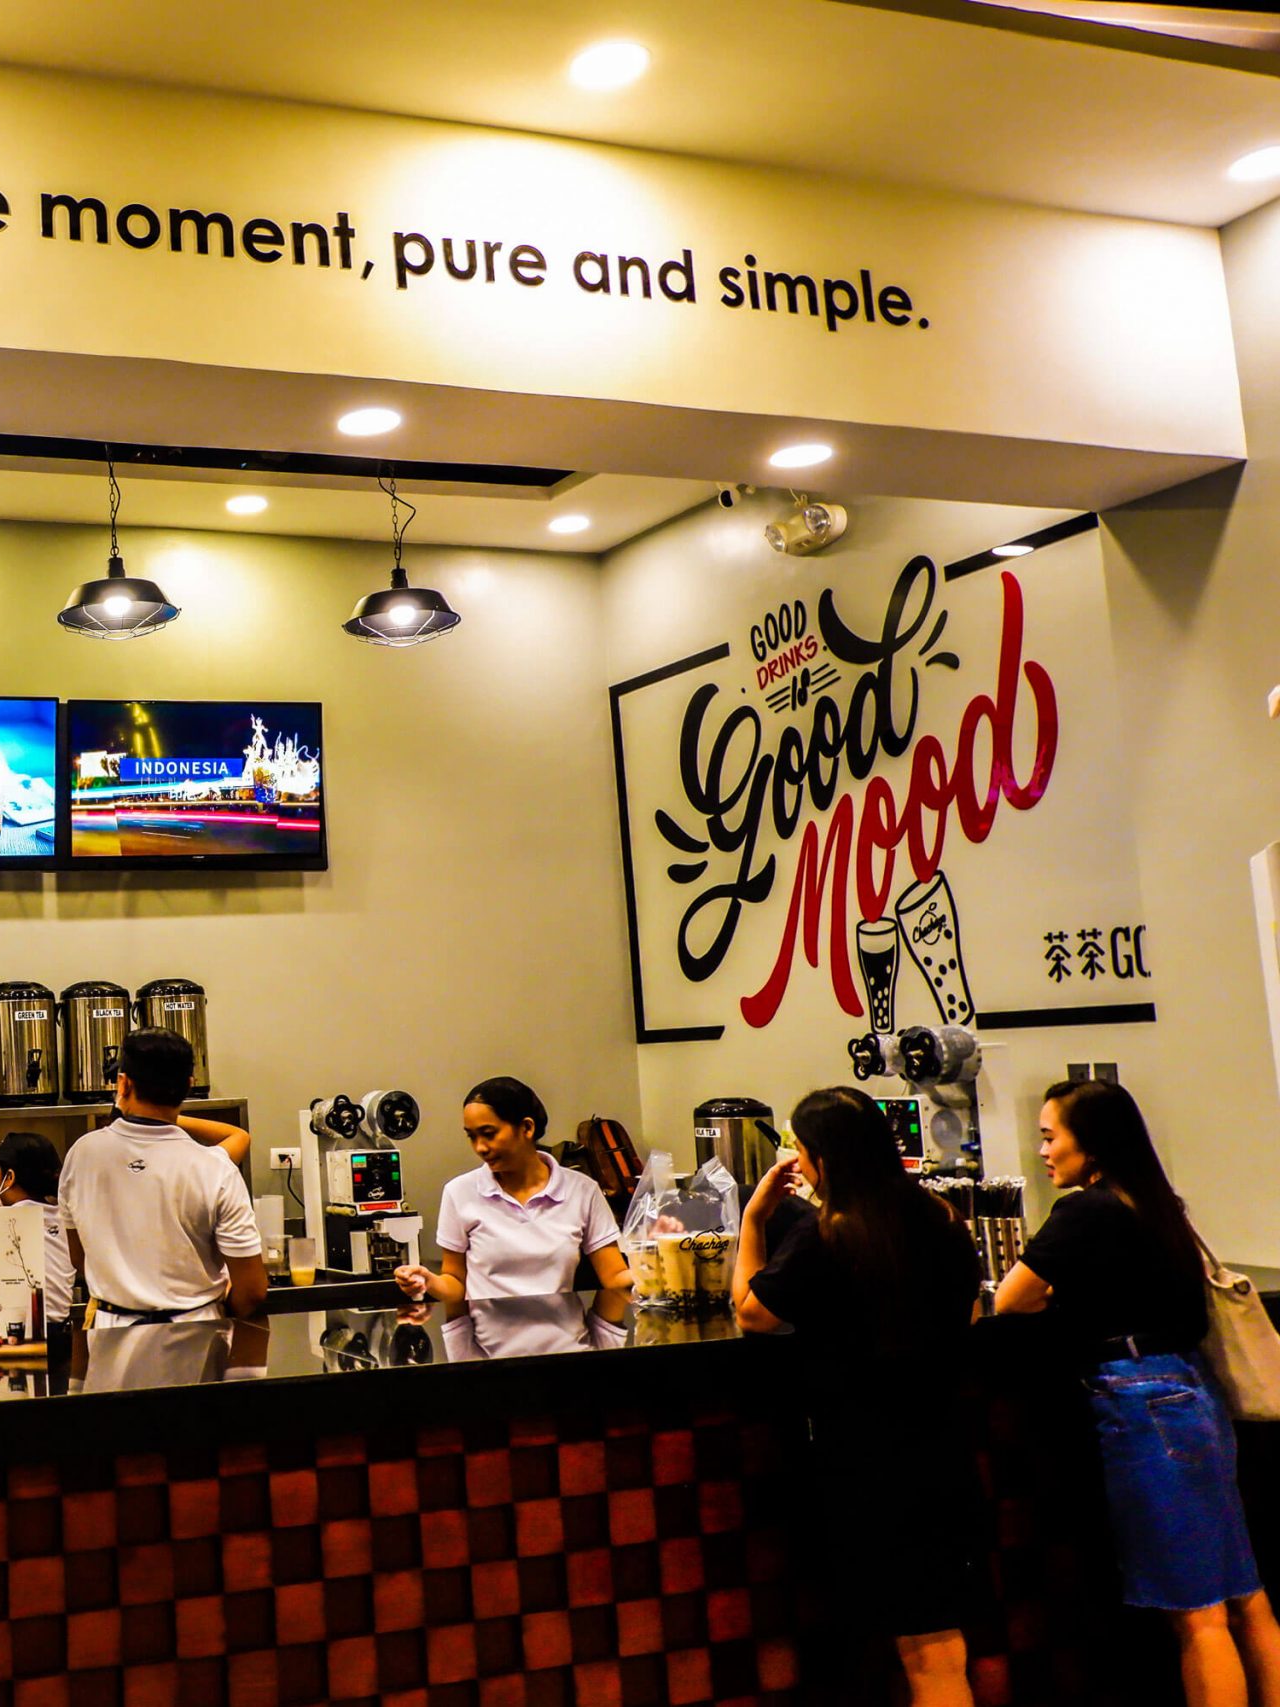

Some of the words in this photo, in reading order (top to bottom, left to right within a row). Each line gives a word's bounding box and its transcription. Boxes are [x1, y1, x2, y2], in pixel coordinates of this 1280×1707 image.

[40, 191, 374, 281] moment,
[392, 230, 548, 289] pure
[572, 248, 697, 304] and
[719, 253, 930, 332] simple.
[750, 599, 807, 662] GOOD
[756, 635, 818, 690] DRINKS
[135, 762, 230, 775] INDONESIA
[677, 555, 938, 983] Good
[739, 570, 1059, 1029] Mood
[18, 1012, 34, 1020] GREEN
